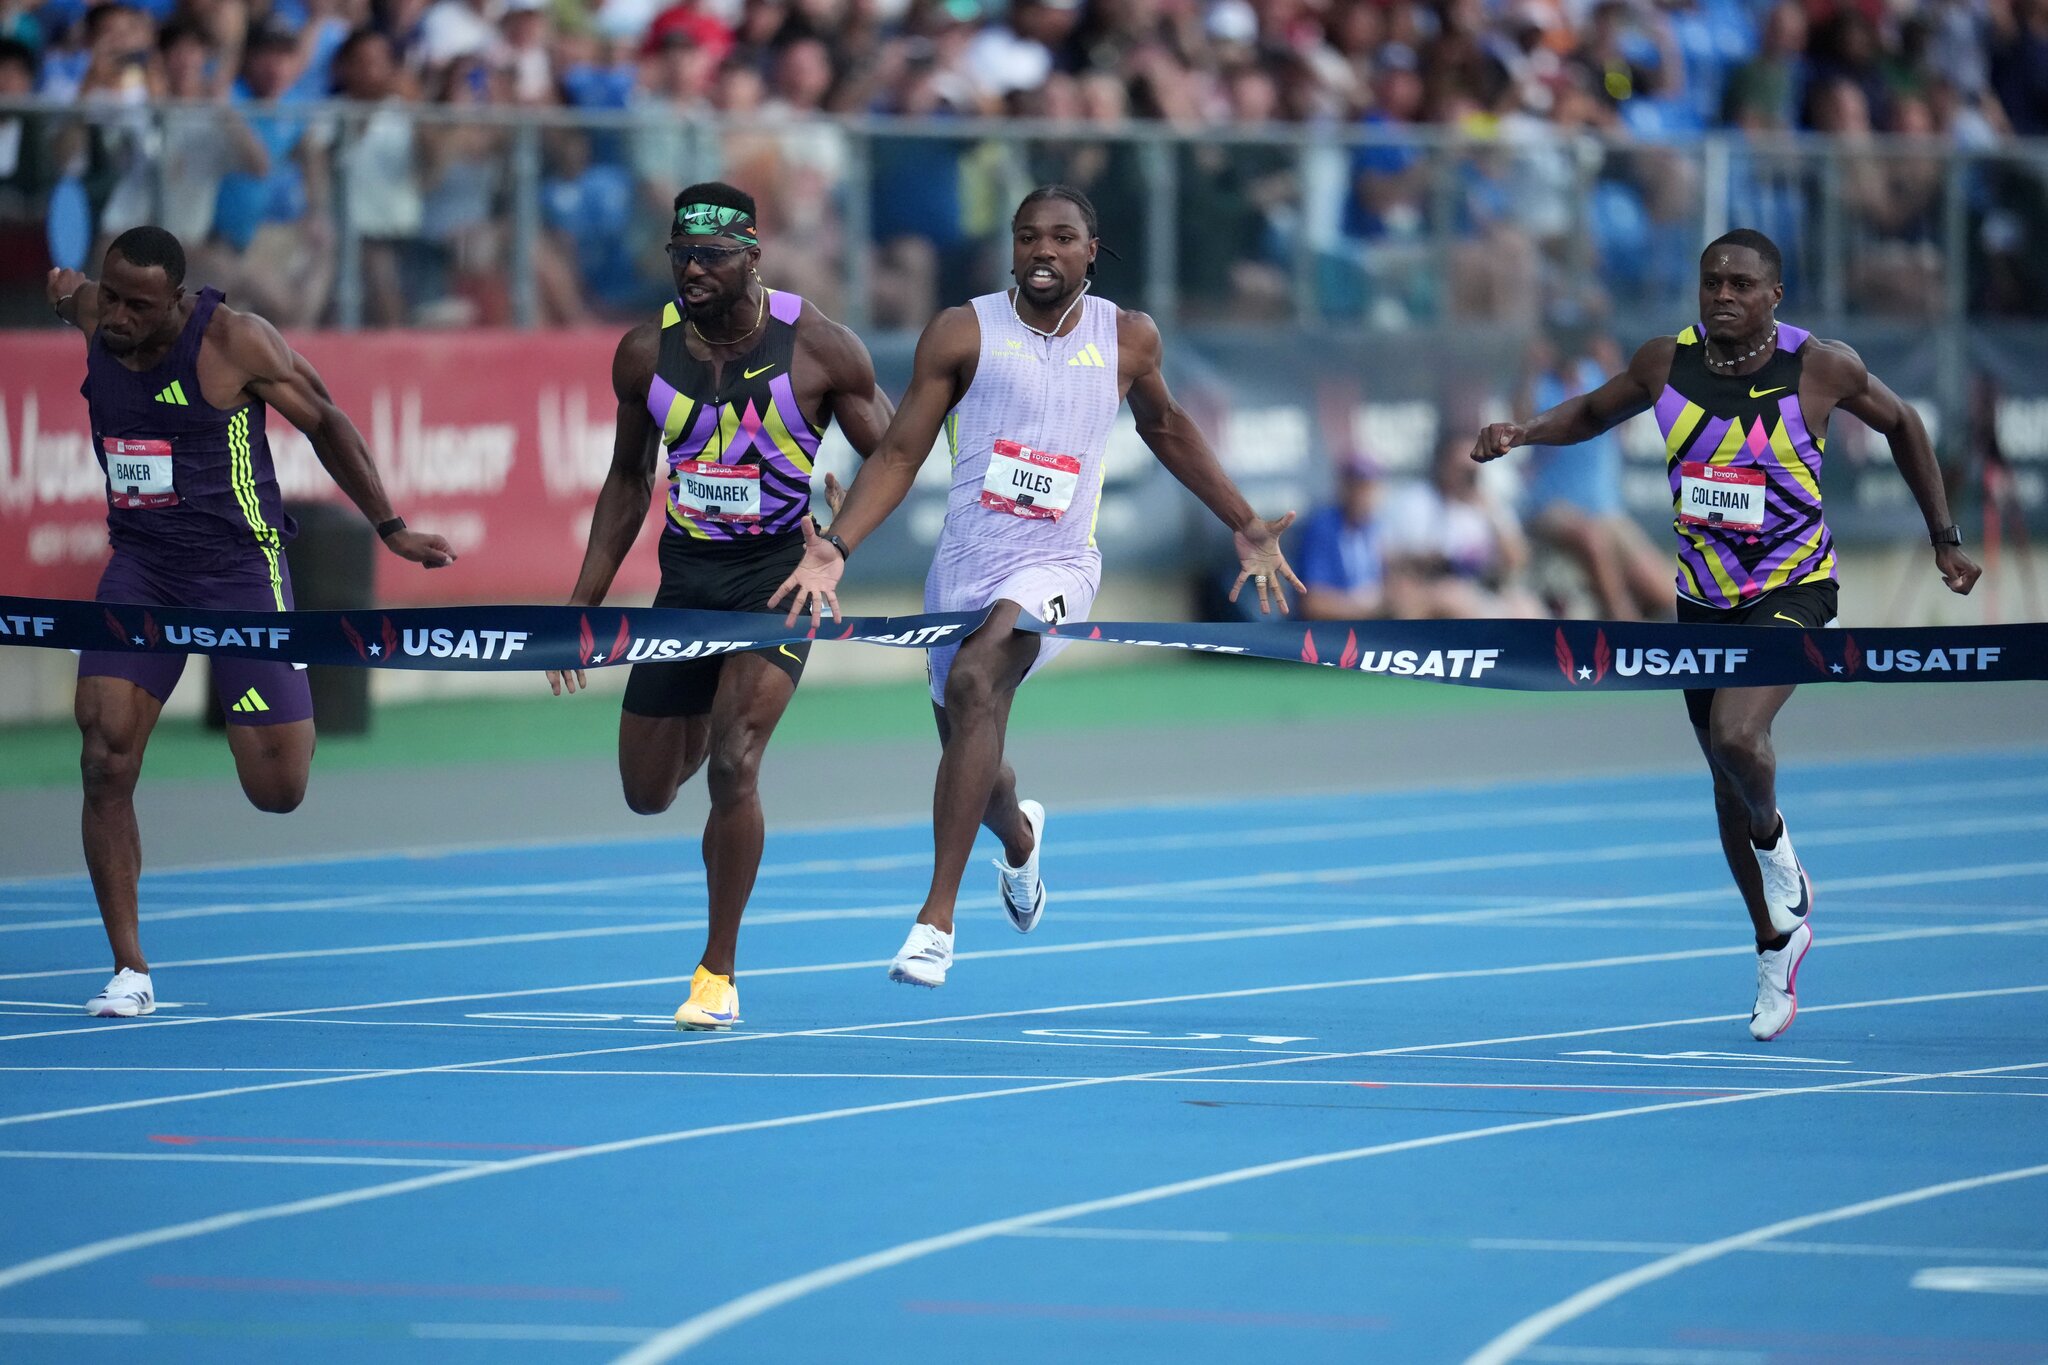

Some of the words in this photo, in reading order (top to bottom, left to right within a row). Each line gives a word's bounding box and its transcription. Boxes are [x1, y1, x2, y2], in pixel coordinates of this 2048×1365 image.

[1031, 453, 1058, 464] TOYOTA
[116, 463, 151, 481] BAKER
[1011, 468, 1053, 494] LYLES
[1713, 470, 1739, 479] TOYOTA
[686, 478, 749, 502] BEDNAREK
[1691, 486, 1750, 510] COLEMAN
[164, 625, 291, 649] USATF
[403, 628, 528, 660] USATF
[848, 623, 963, 645] ATF
[1360, 648, 1499, 679] USATF
[1614, 648, 1750, 676] USATF
[1866, 647, 2001, 673] USATF
